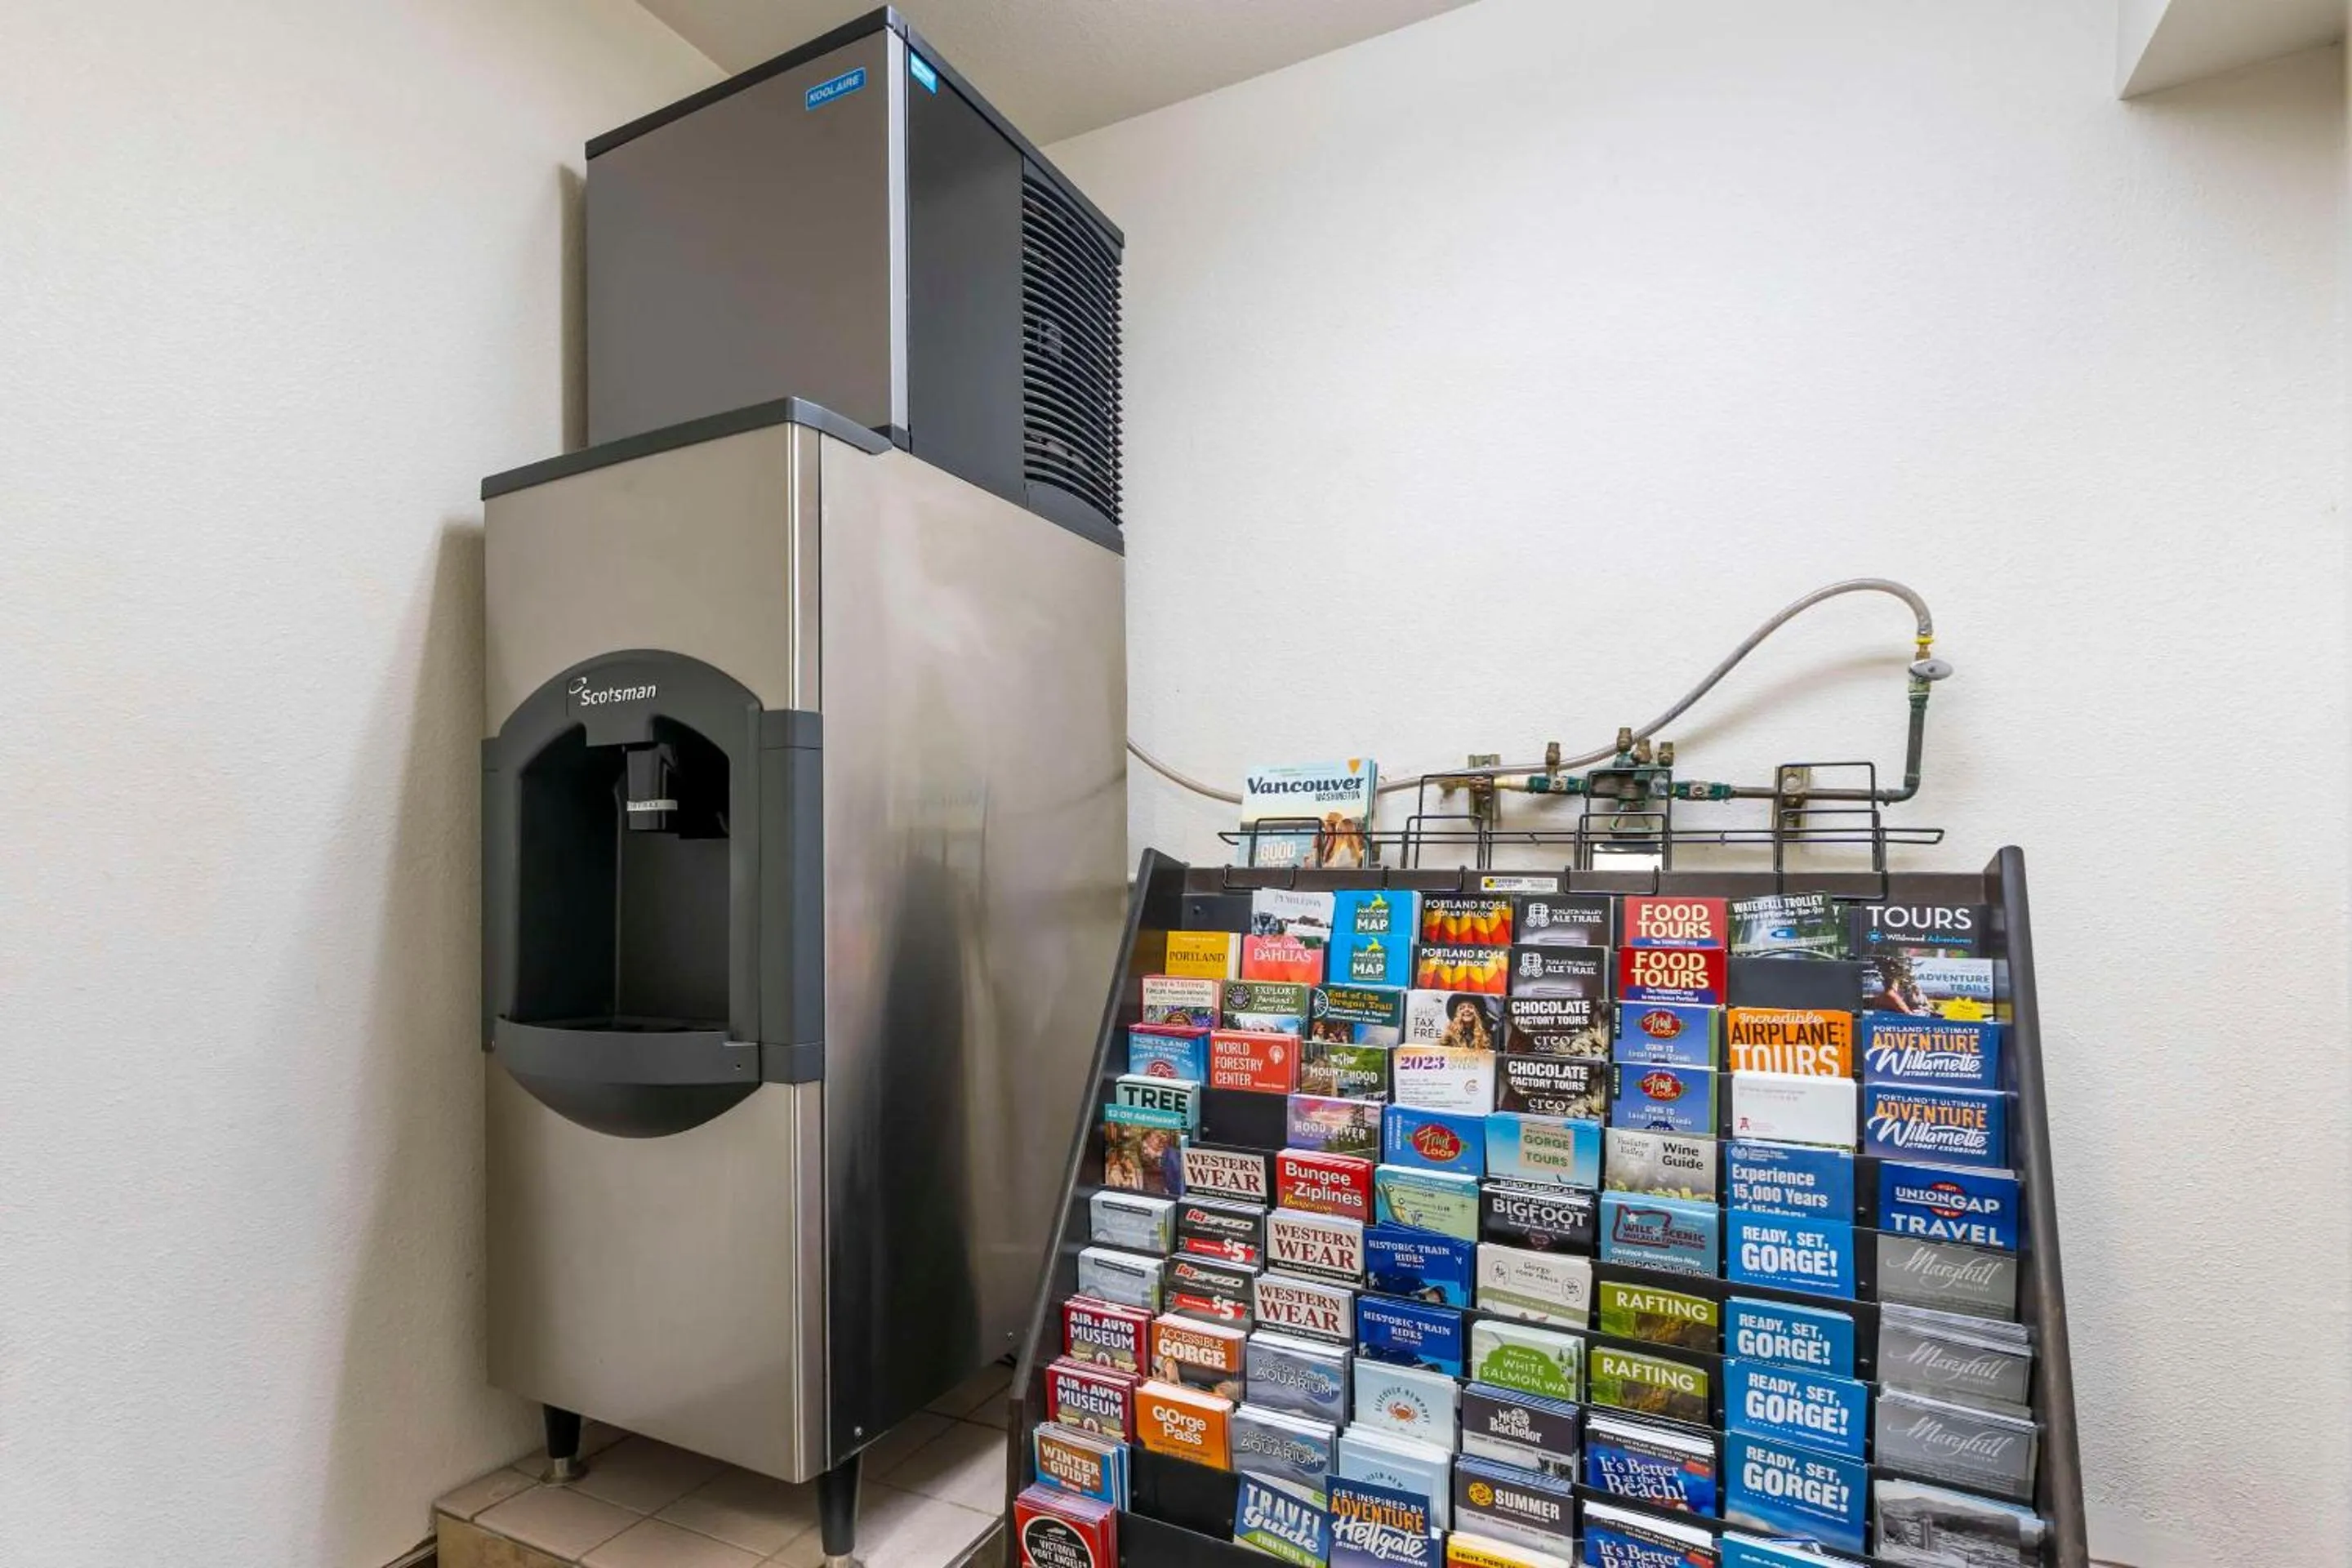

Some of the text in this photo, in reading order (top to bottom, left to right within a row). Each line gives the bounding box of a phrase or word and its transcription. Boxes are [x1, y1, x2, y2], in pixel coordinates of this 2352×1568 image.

[808, 74, 860, 102] KOOLAIRE
[580, 684, 657, 706] Scotsman
[1248, 777, 1365, 795] Vancouver
[1315, 791, 1361, 802] WASHINGTON
[1425, 900, 1507, 910] PORTLAND ROSE
[1641, 904, 1708, 921] FOOD
[1784, 895, 1823, 907] TROLLEY
[1357, 919, 1388, 931] MAP
[1552, 915, 1602, 923] ALE TRAIL
[1637, 920, 1711, 939] TOURS
[1865, 905, 1971, 930] TOURS
[1169, 951, 1226, 963] PORTLAND
[1254, 948, 1312, 963] DAHLIAS
[1422, 949, 1504, 959] PORTLAND ROSE
[1635, 951, 1706, 971] FOOD
[1353, 964, 1384, 975] MAP
[1545, 965, 1597, 975] ALE TRAIL
[1630, 969, 1709, 989] TOURS
[1918, 973, 1990, 983] ADVENTURE
[1254, 986, 1298, 996] EXPLORE
[1949, 983, 1990, 993] TRAILS
[1512, 1000, 1590, 1015] CHOCOLATE
[1414, 1018, 1435, 1027] TAX
[1515, 1016, 1588, 1025] FACTORY TOURS
[1414, 1028, 1442, 1038] FREE
[1731, 1021, 1838, 1045] AIRPLANE
[1872, 1032, 1980, 1054] ADVENTURE
[1215, 1041, 1250, 1055] WORLD
[1214, 1058, 1263, 1071] FORESTRY
[1400, 1055, 1446, 1070] 2023
[1508, 1062, 1588, 1080] CHOCOLATE
[1731, 1045, 1838, 1077] TOURS
[1864, 1045, 1984, 1076] Willamette
[1215, 1072, 1251, 1085] CENTER
[1310, 1066, 1378, 1084] MOUNT HOOD
[1511, 1076, 1585, 1091] FACTORY TOURS
[1124, 1086, 1187, 1114] TREE
[1875, 1102, 1988, 1129] ADVENTURE
[1294, 1121, 1366, 1140] HOOD RIVER
[1523, 1134, 1570, 1150] GORGE
[1867, 1114, 1990, 1148] Willamette
[1525, 1152, 1568, 1167] TOURS
[1663, 1143, 1699, 1156] Wine
[1186, 1153, 1262, 1173] WESTERN
[1285, 1161, 1351, 1186] Bungee
[1662, 1156, 1704, 1170] Guide
[1732, 1163, 1815, 1186] Experience
[1187, 1167, 1261, 1192] WEAR
[1294, 1182, 1362, 1207] Ziplines
[1500, 1192, 1579, 1211] NORTH AMERICAN
[1732, 1183, 1828, 1208] 15,000 Years
[1493, 1198, 1587, 1227] BIGFOOT
[1274, 1223, 1357, 1248] WESTERN
[1742, 1226, 1829, 1250] READY, SET,
[1891, 1213, 2004, 1246] TRAVEL
[1276, 1238, 1356, 1271] WEAR
[1369, 1240, 1450, 1255] HISTORIC TRAIN
[1395, 1254, 1424, 1263] RIDES
[1741, 1244, 1838, 1278] GORGE!
[1886, 1247, 2003, 1289] Maryhill
[1258, 1285, 1340, 1310] WESTERN
[1616, 1291, 1708, 1321] RAFTING
[1069, 1312, 1092, 1325] AIR
[1101, 1318, 1134, 1333] AUTO
[1258, 1298, 1340, 1333] WEAR
[1363, 1311, 1450, 1336] HISTORIC TRAIN
[1739, 1313, 1823, 1339] READY, SET,
[1070, 1326, 1135, 1351] MUSEUM
[1160, 1327, 1224, 1349] ACCESSIBLE
[1391, 1327, 1423, 1339] RIDES
[1158, 1339, 1226, 1368] GORGE
[1737, 1330, 1831, 1365] GORGE!
[1503, 1359, 1544, 1374] WHITE
[1602, 1357, 1695, 1391] RAFTING
[1887, 1342, 2011, 1382] Maryhill
[1057, 1376, 1080, 1392] AIR
[1089, 1384, 1123, 1401] AUTO
[1255, 1367, 1333, 1396] AQUARIUM
[1483, 1366, 1566, 1393] SALMON, WA
[1748, 1373, 1840, 1407] READY, SET,
[1058, 1389, 1123, 1419] MUSEUM
[1746, 1391, 1849, 1436] GORGE!
[1152, 1405, 1207, 1432] GOrge
[1489, 1417, 1543, 1443] Bachelor
[1164, 1424, 1202, 1445] Pass
[1886, 1417, 2013, 1456] Maryhill
[1041, 1443, 1100, 1476] WINTER
[1241, 1437, 1318, 1467] AQUARIUM
[1049, 1460, 1090, 1486] GUIDE
[1598, 1456, 1679, 1477] It's Better
[1746, 1446, 1840, 1484] READY, SET,
[1602, 1473, 1687, 1501] Beach!
[1637, 1474, 1656, 1483] the
[1743, 1463, 1849, 1513] GORGE!
[1333, 1488, 1425, 1513] GET INSPIRED BY
[1494, 1488, 1560, 1521] SUMMER
[1330, 1496, 1424, 1534] ADVENTURE
[1244, 1507, 1319, 1552] Guide
[1332, 1516, 1430, 1559] Hellgate
[1031, 1547, 1052, 1563] PORT
[1597, 1539, 1681, 1566] It's Better
